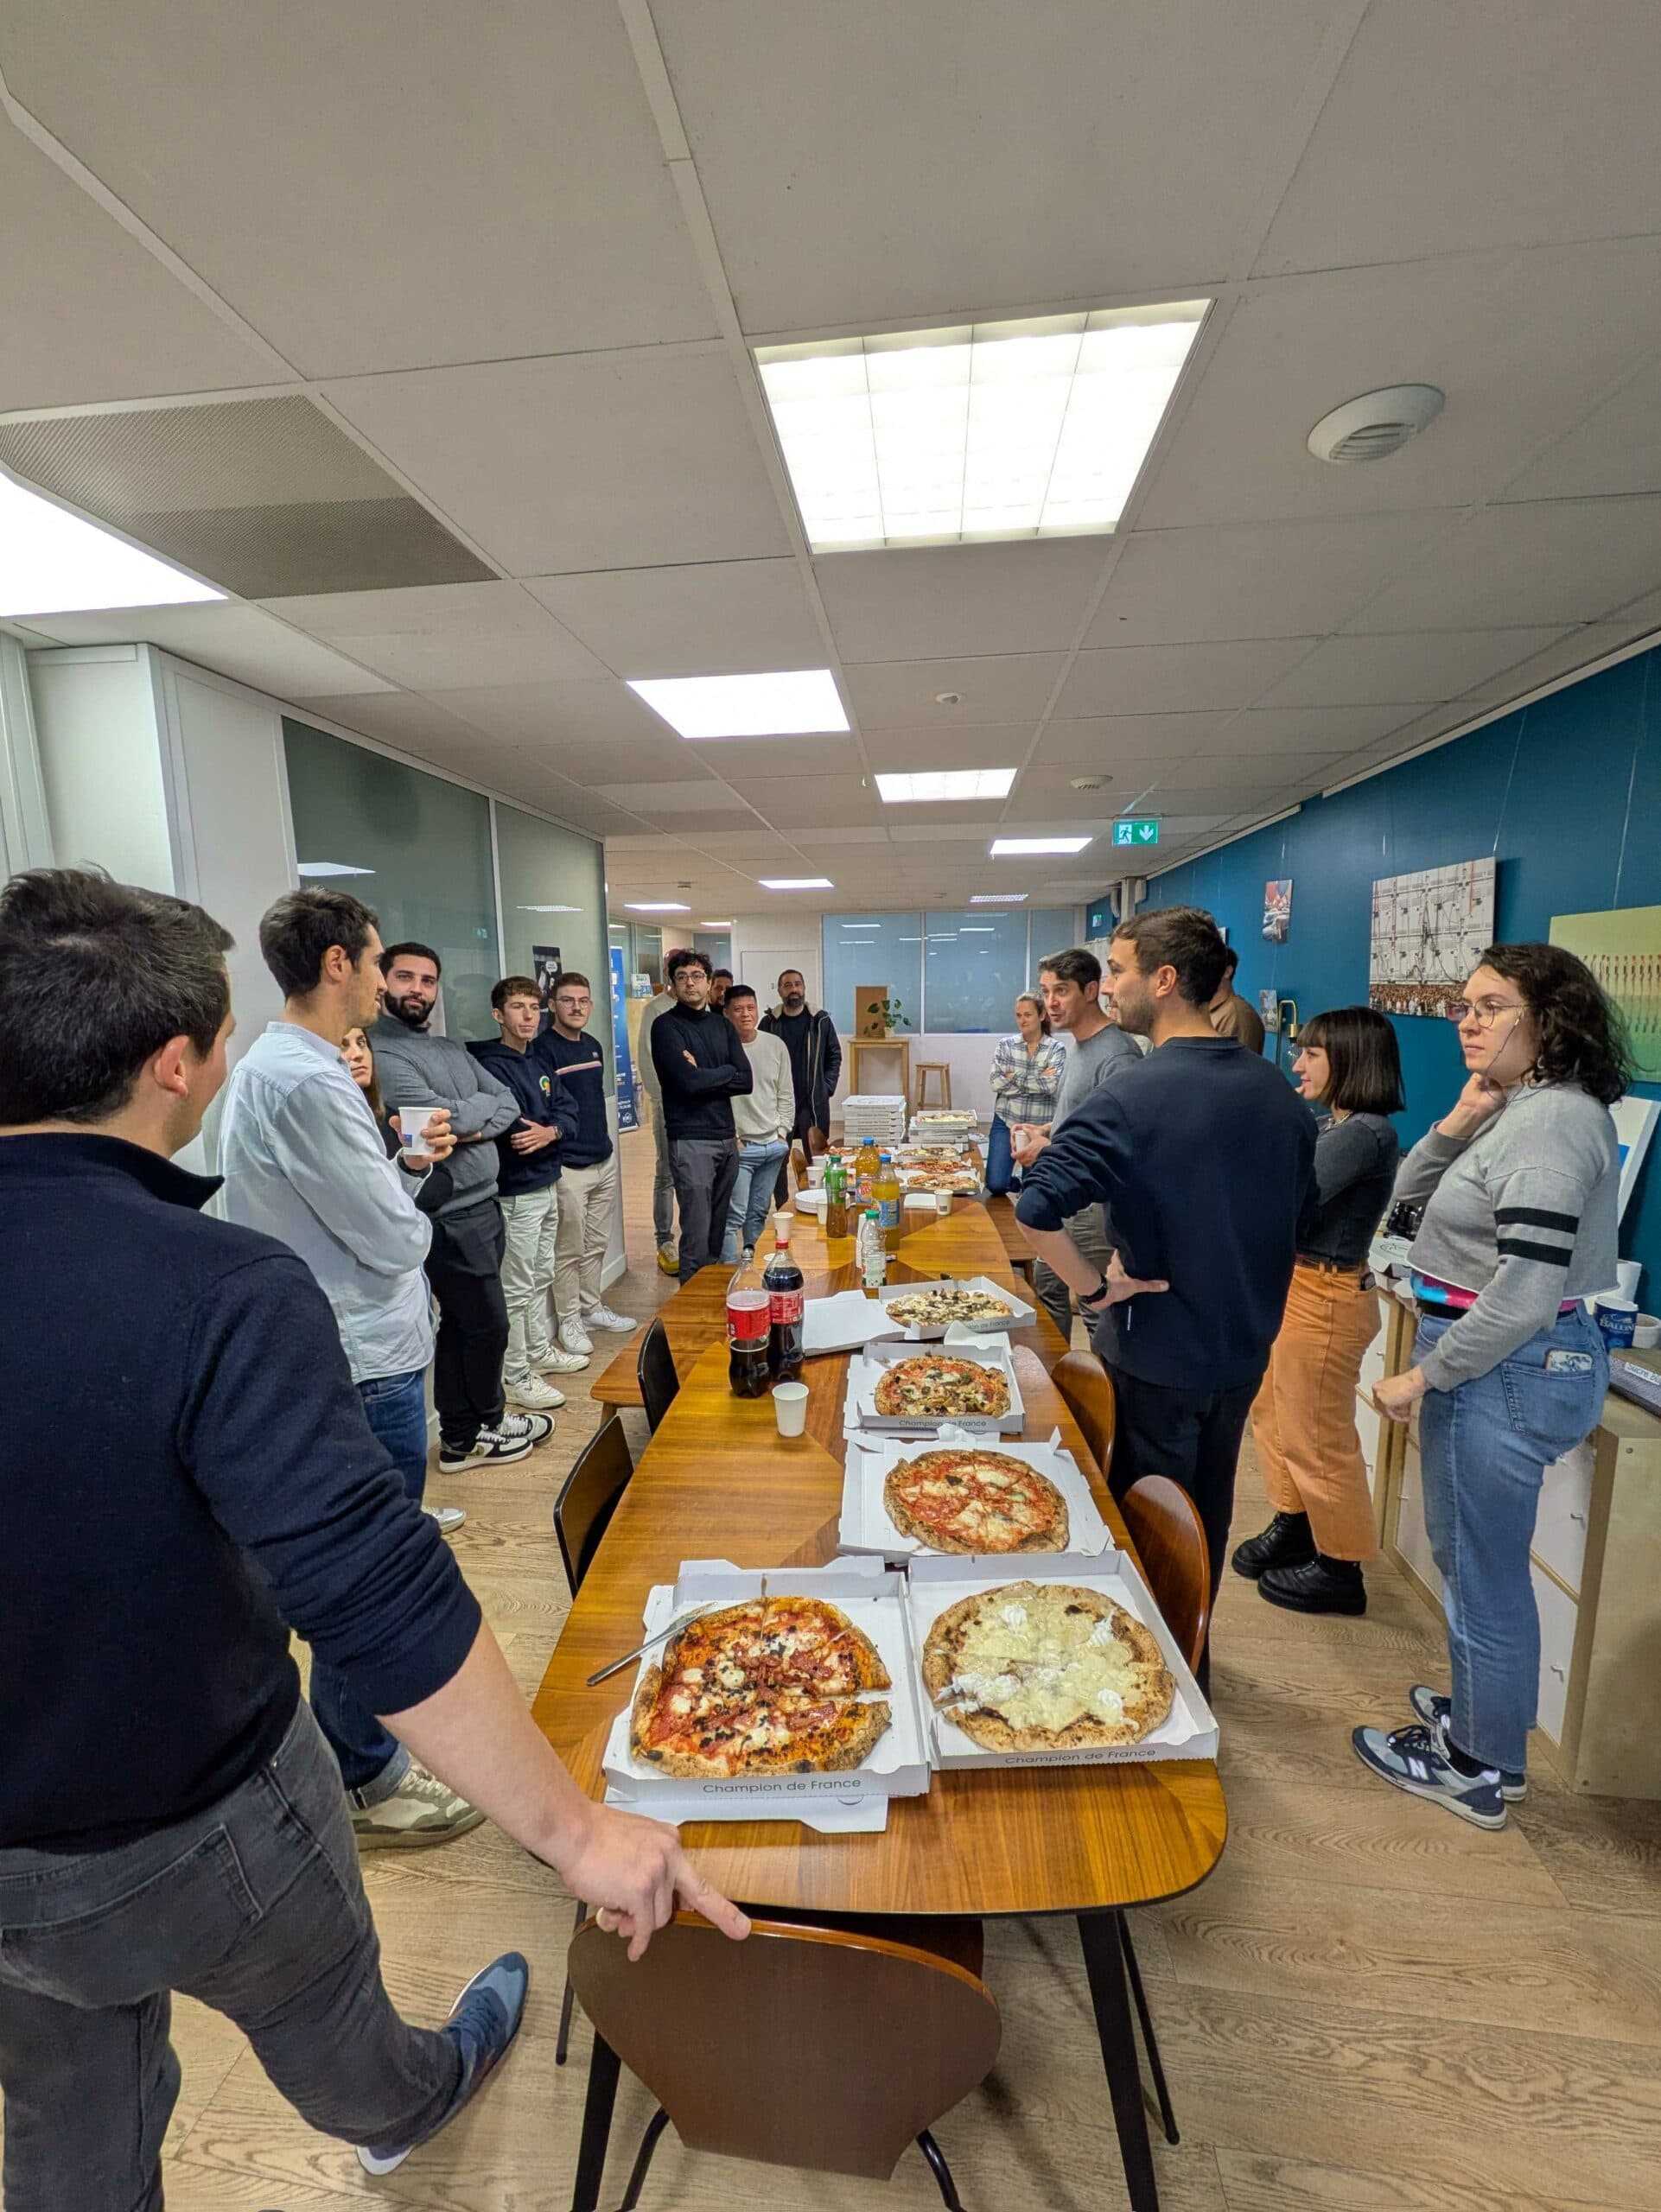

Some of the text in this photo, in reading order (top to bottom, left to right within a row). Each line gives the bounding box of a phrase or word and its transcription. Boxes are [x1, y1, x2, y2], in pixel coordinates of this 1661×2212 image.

[899, 1419, 944, 1428] Champion
[1005, 1754, 1080, 1765] Champion
[1108, 1749, 1156, 1759] France
[703, 1777, 862, 1794] Champion de France
